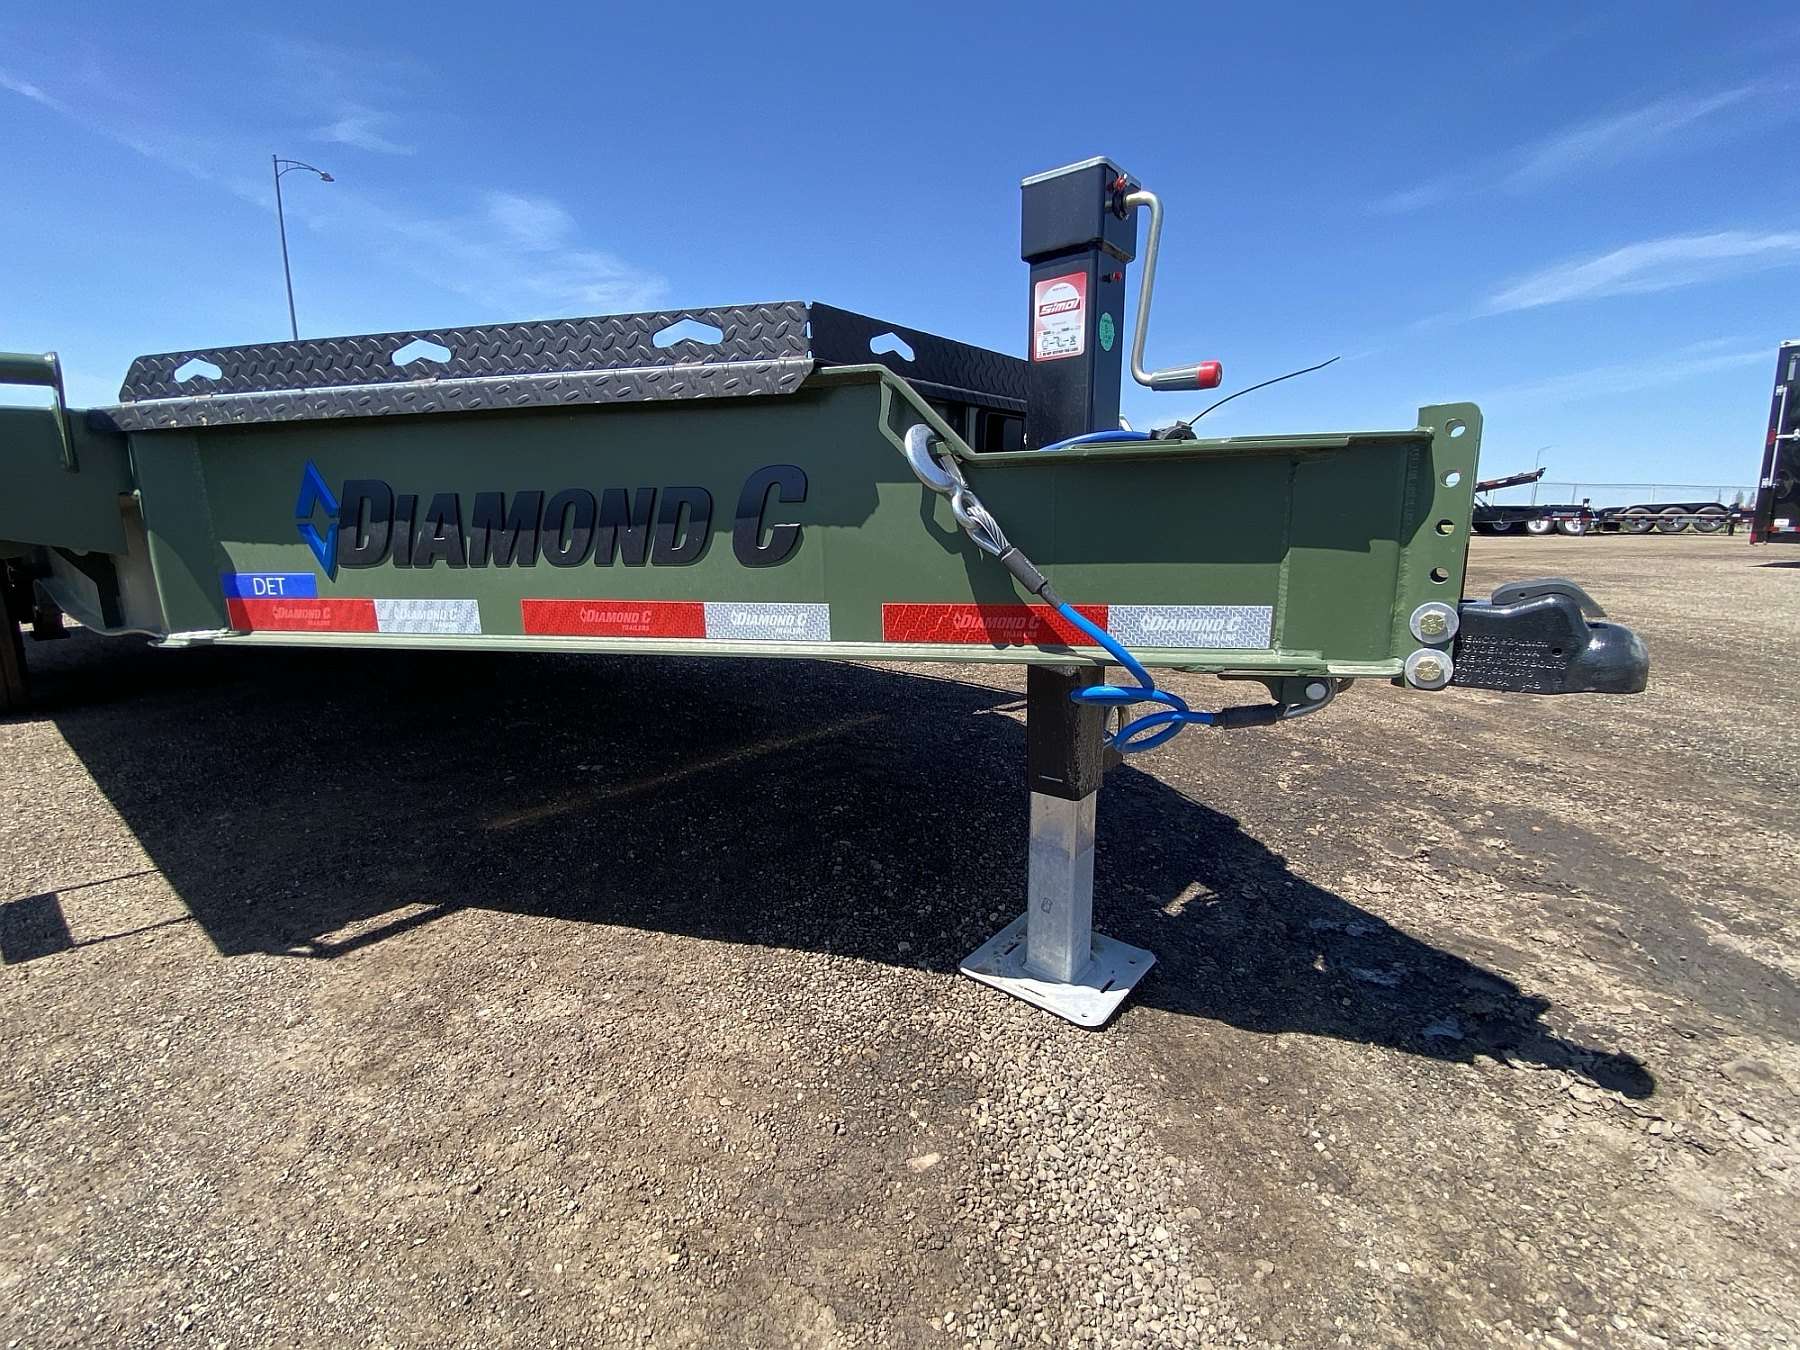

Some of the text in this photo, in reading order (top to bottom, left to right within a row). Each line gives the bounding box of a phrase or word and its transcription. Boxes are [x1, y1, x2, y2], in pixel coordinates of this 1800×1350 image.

[338, 463, 809, 569] DIAMOND C
[252, 577, 286, 595] DET
[277, 607, 332, 619] DIAMOND C
[587, 609, 653, 624] DIAMOND C
[738, 611, 807, 626] DIAMOND C
[960, 614, 1042, 630] DIAMOND C
[1150, 615, 1240, 632] DIAMOND C
